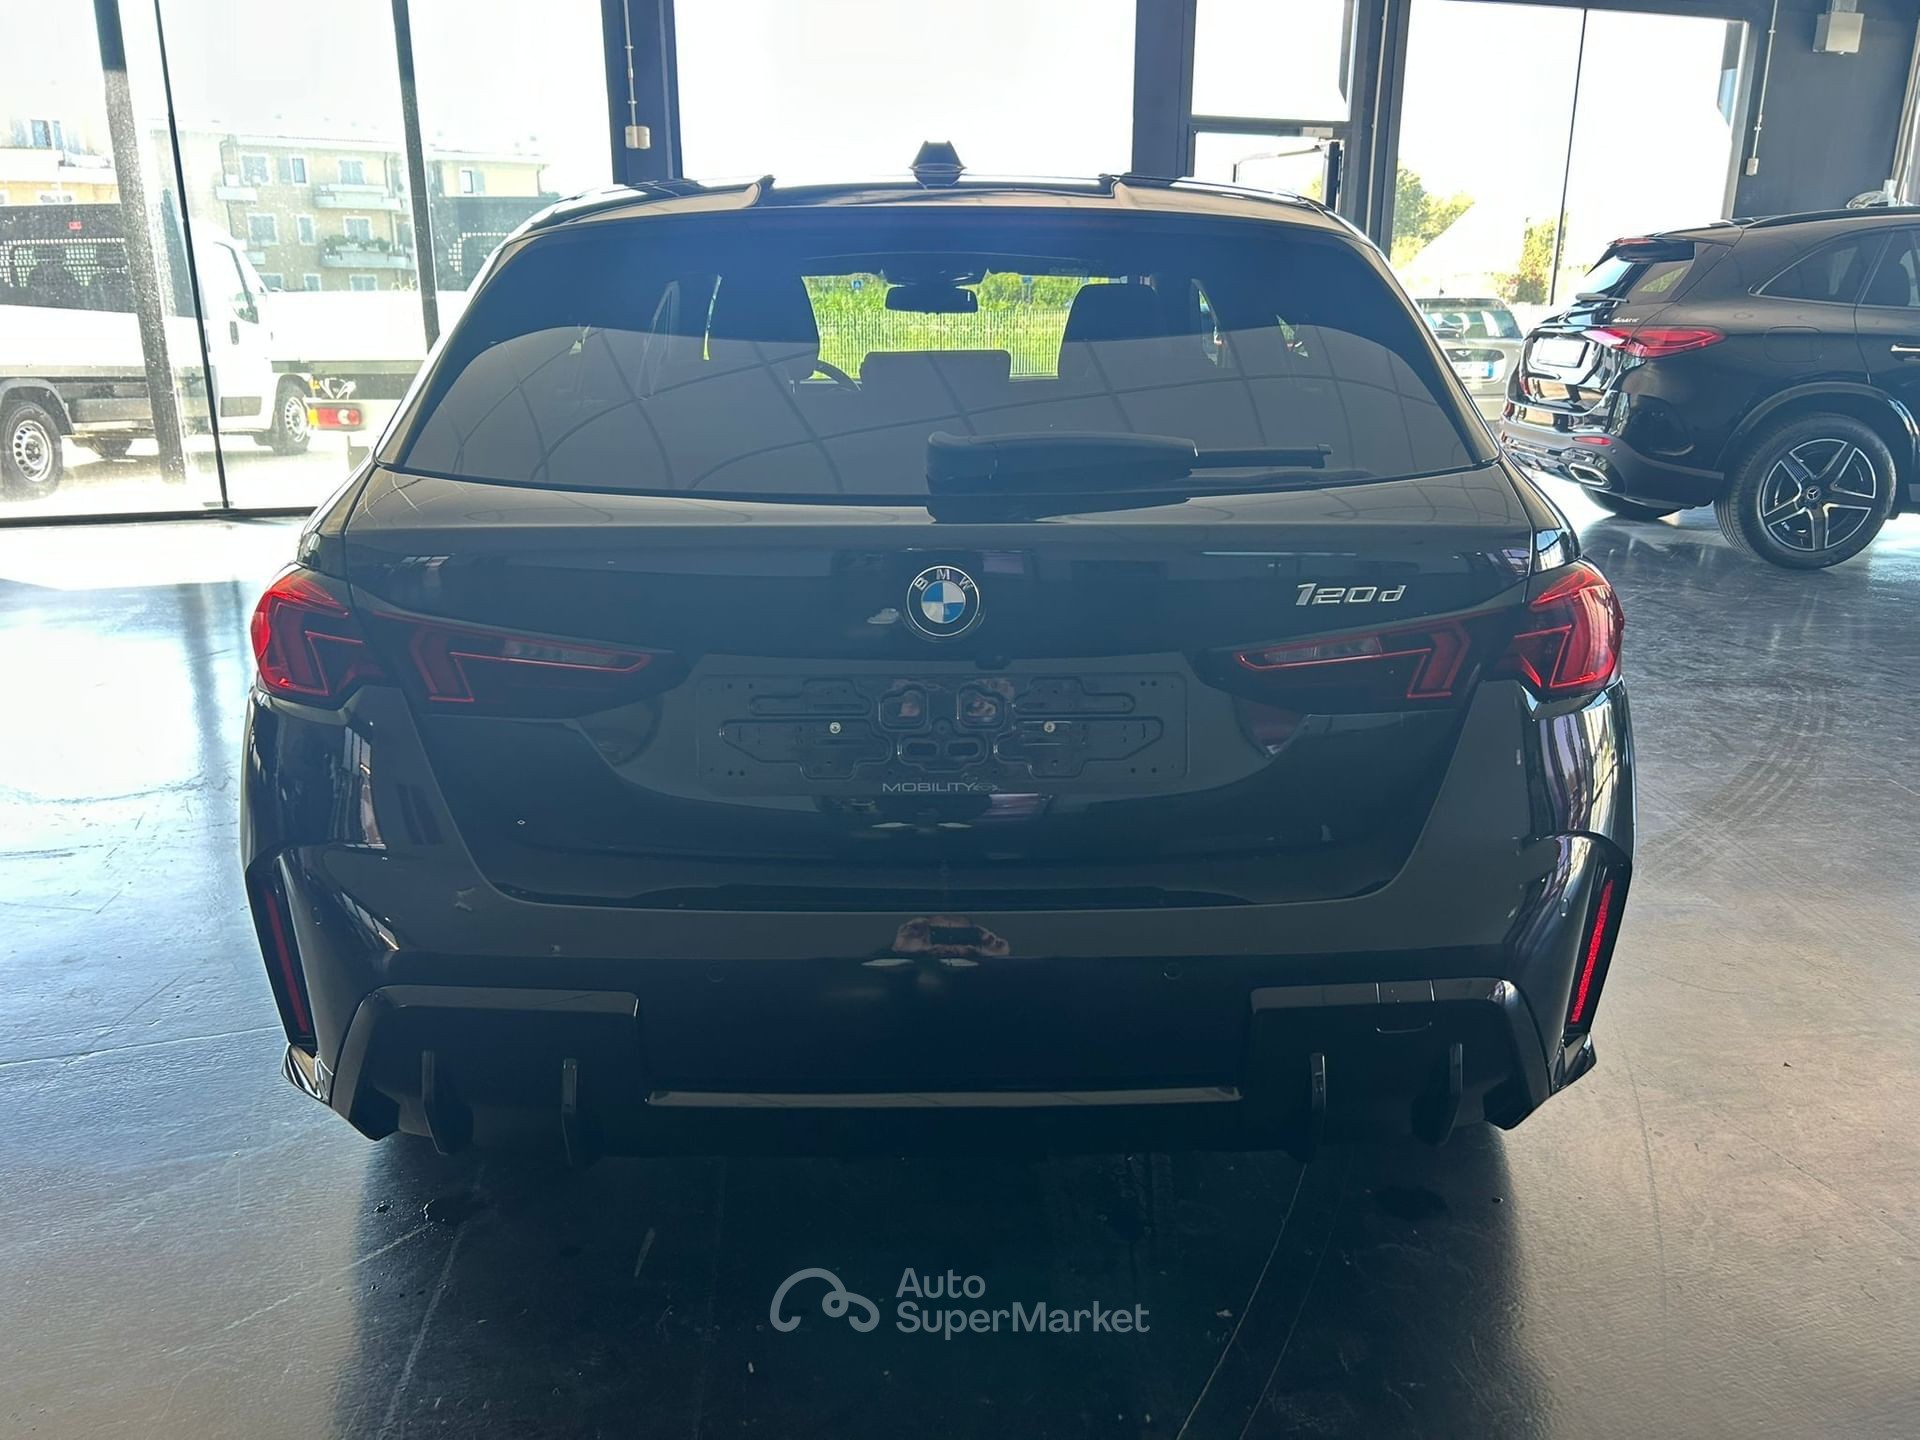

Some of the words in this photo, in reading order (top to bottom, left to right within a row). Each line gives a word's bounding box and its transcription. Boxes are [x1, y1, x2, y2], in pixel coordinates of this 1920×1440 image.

[914, 568, 974, 591] BMW
[1295, 583, 1407, 606] 120d
[882, 782, 976, 793] MOBILITY
